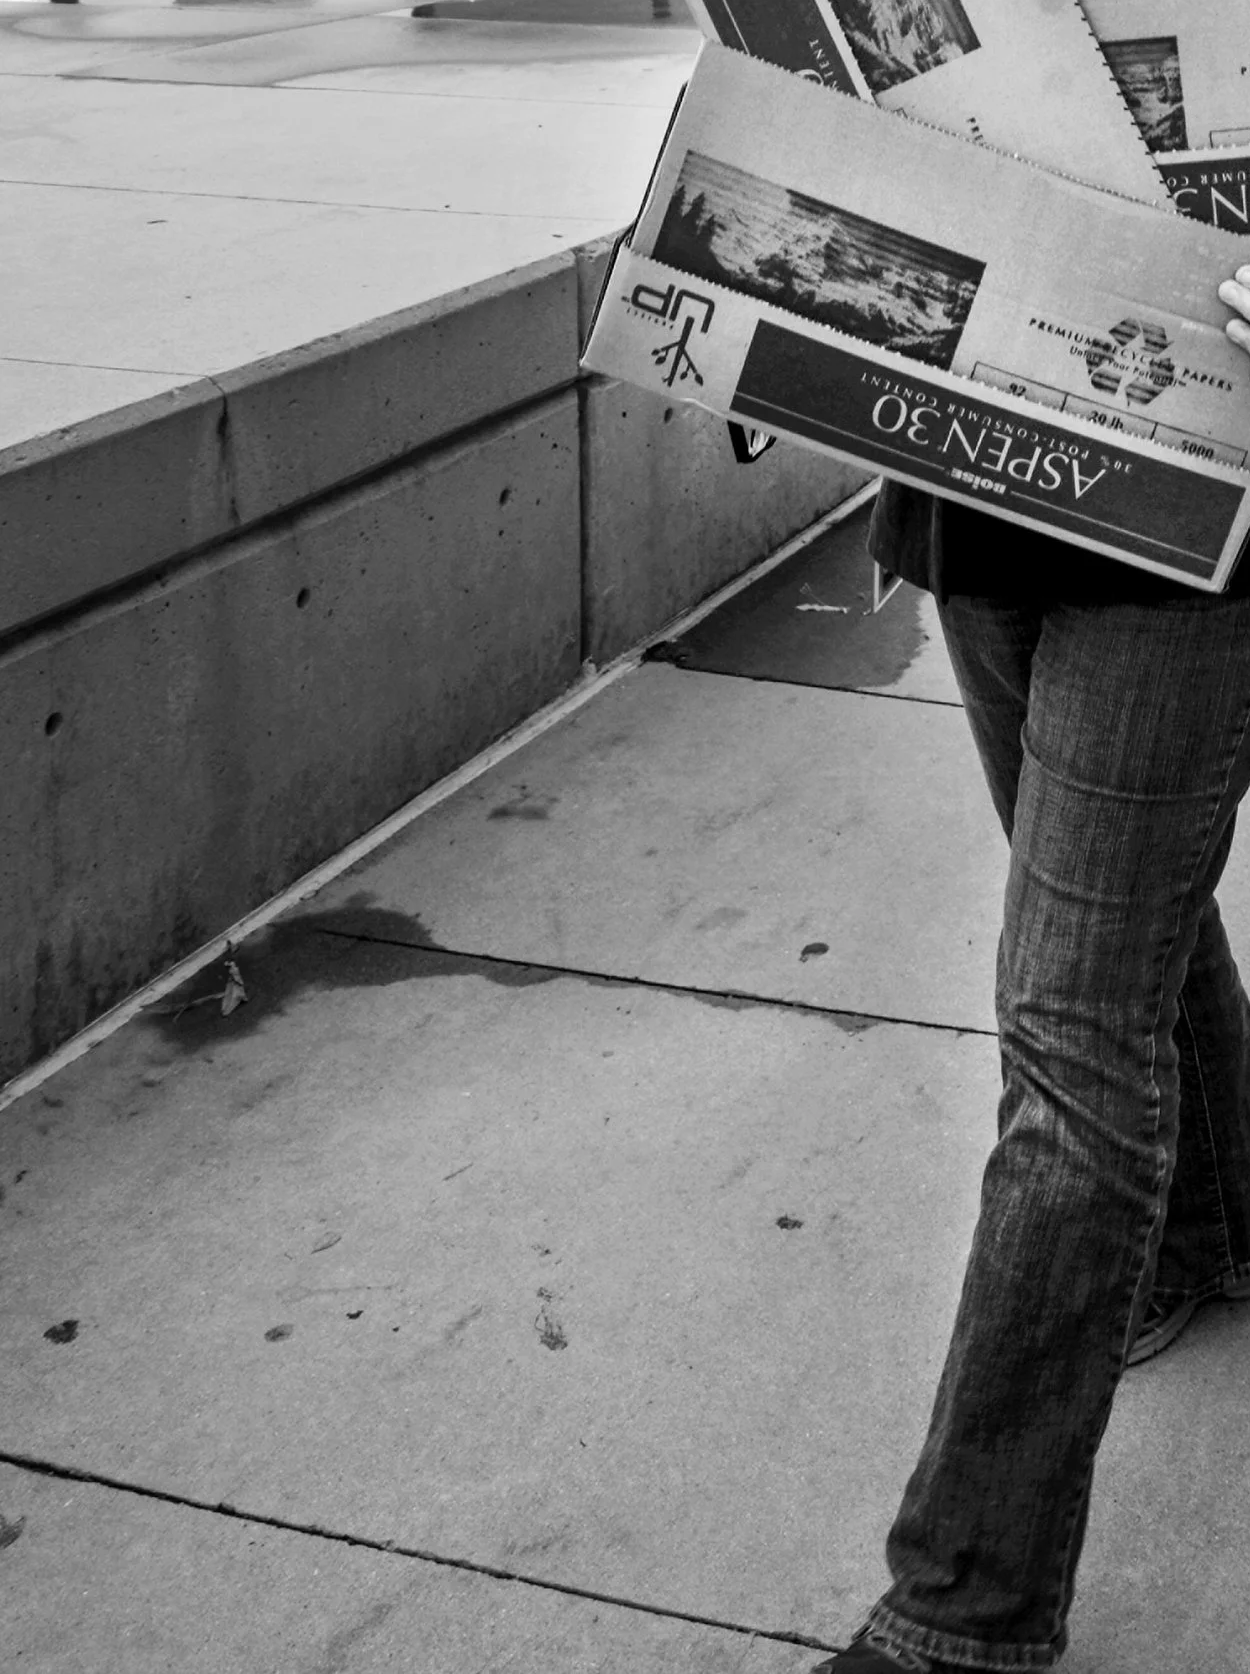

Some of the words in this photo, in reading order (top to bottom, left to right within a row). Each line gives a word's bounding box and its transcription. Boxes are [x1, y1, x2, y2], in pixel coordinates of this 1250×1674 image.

[631, 283, 716, 334] UP
[1028, 317, 1098, 347] PREMIUM
[1182, 367, 1233, 392] PAPERS
[860, 372, 938, 407] CONTENT
[1008, 382, 1027, 397] 92
[872, 393, 941, 446] 30
[947, 402, 1090, 460] POST-CONSUMER
[1089, 410, 1107, 426] 20
[942, 418, 1107, 500] ASPEN
[1101, 454, 1132, 473] 30%
[1181, 439, 1215, 460] 5000
